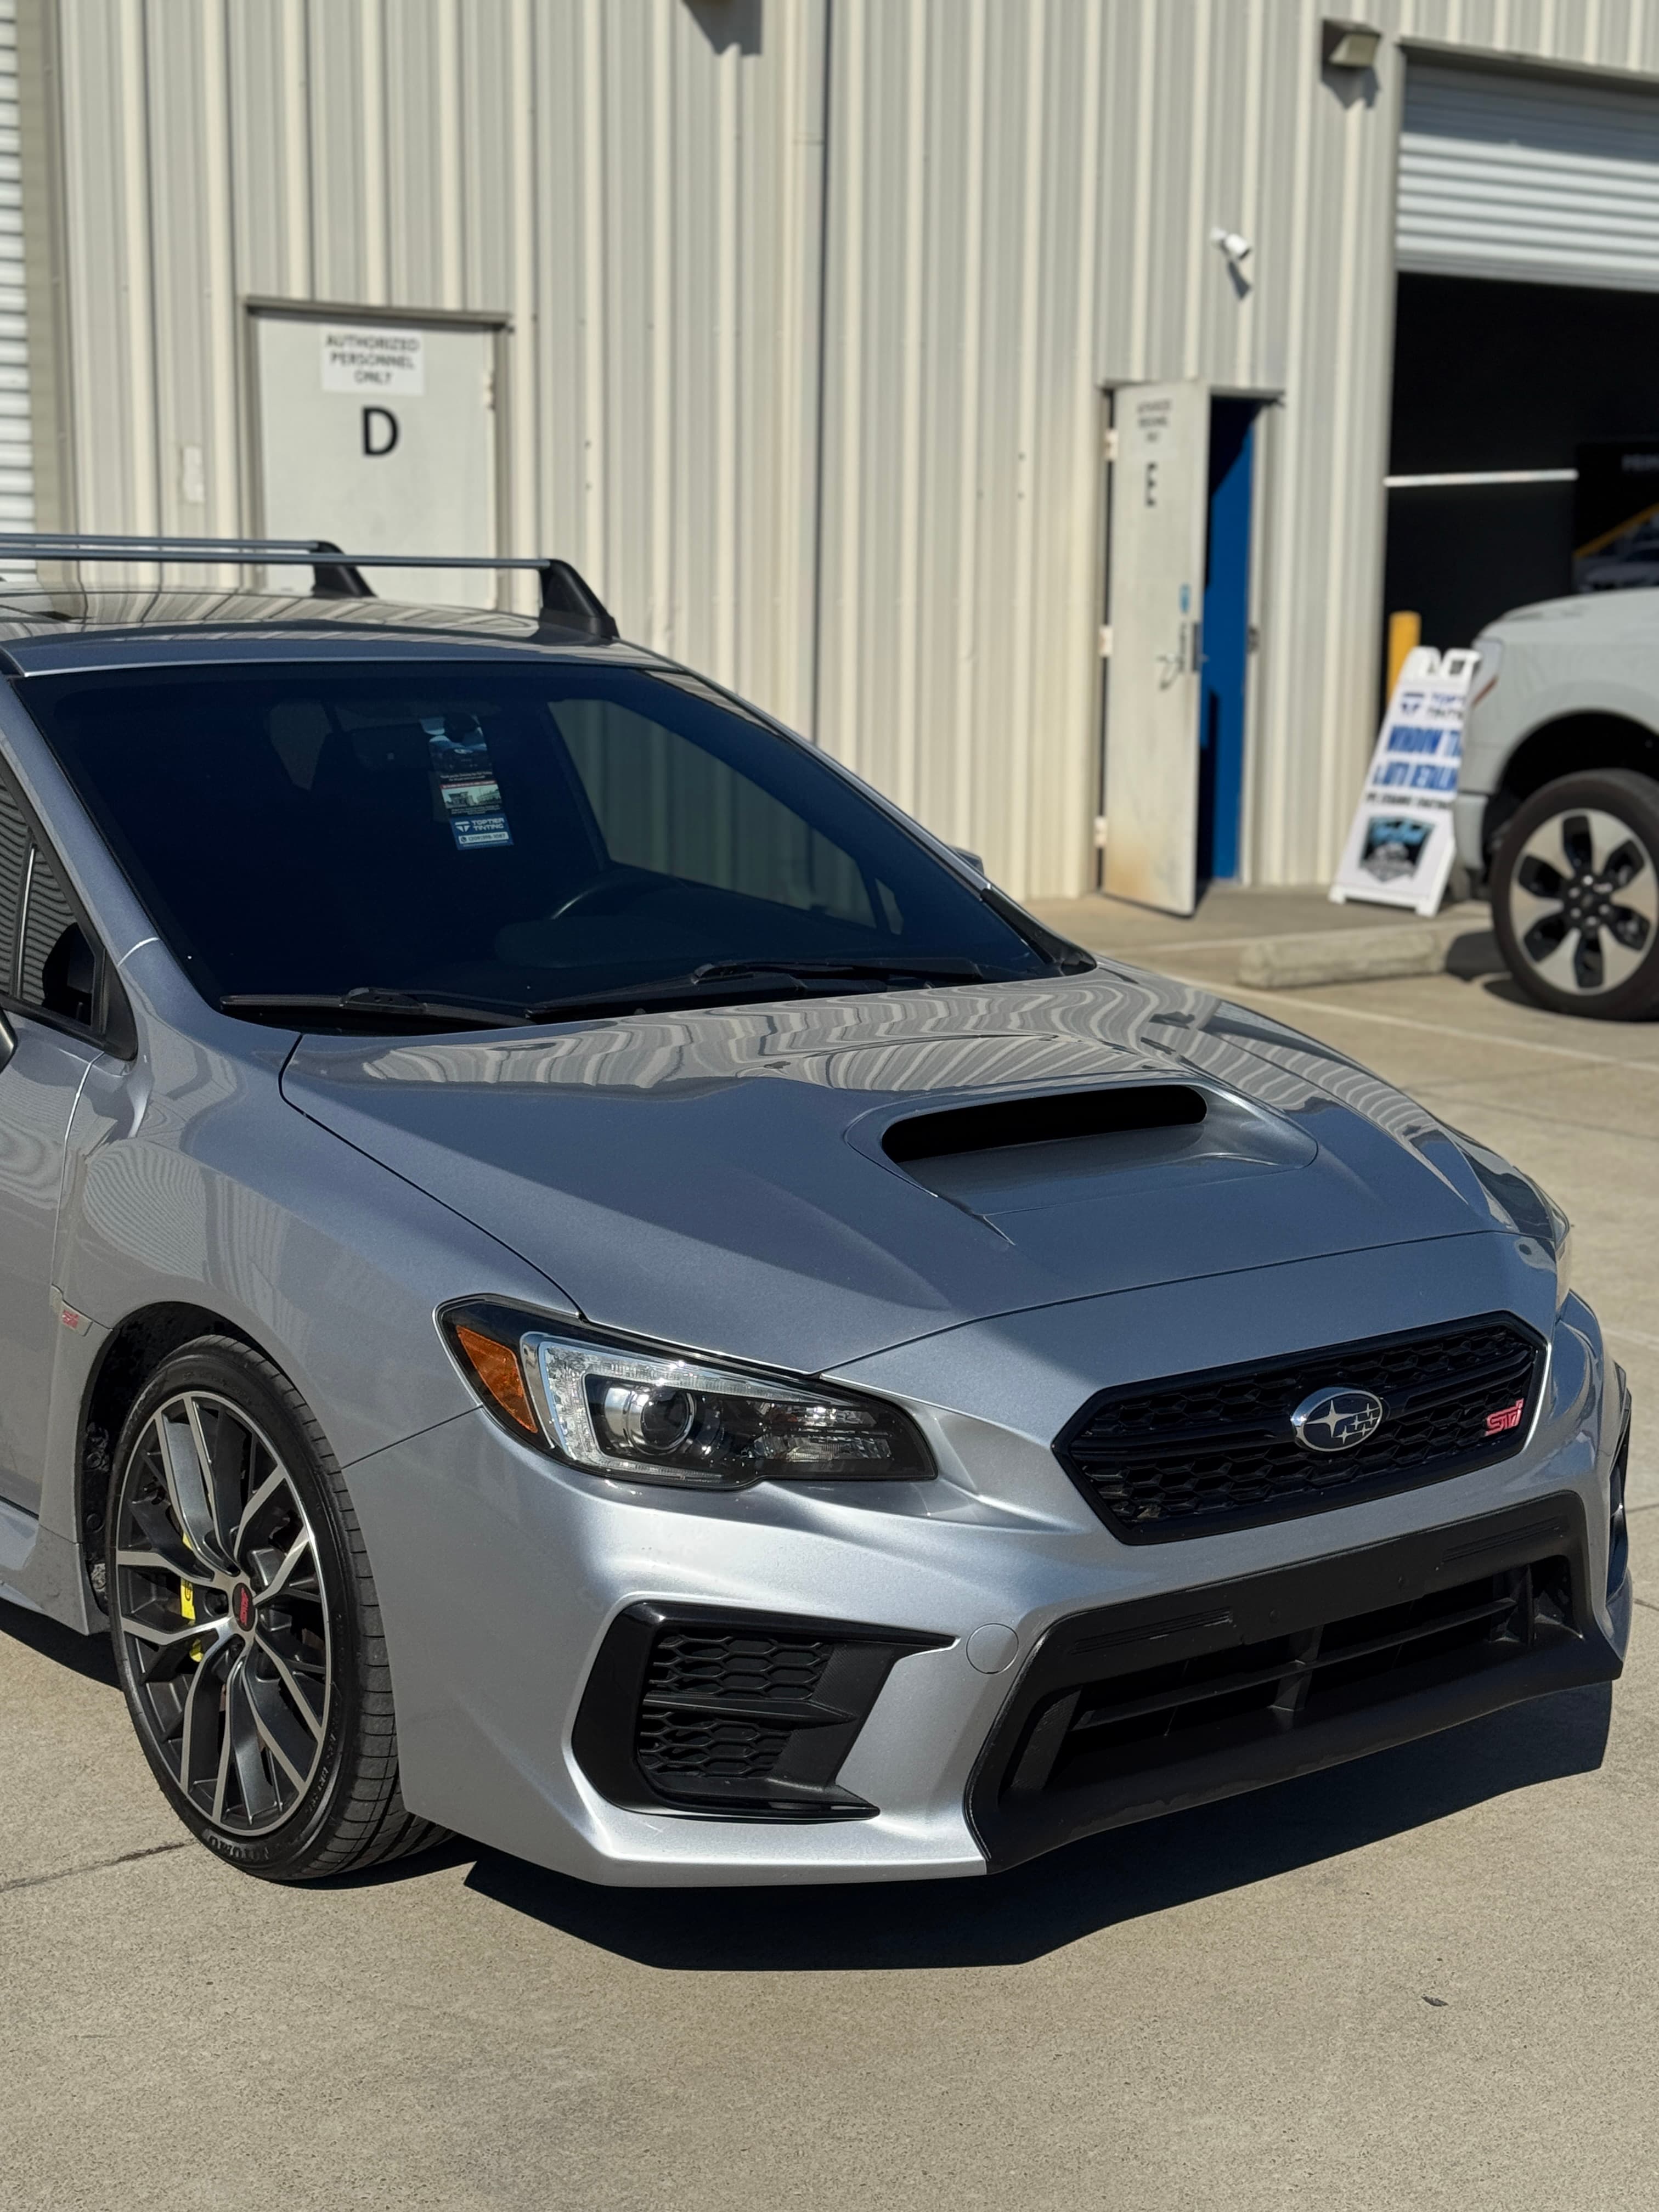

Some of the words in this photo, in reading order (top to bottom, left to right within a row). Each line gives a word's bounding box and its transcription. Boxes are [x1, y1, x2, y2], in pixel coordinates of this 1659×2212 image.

[326, 334, 420, 351] AUTHORIZED
[330, 351, 415, 370] PERSONNEL
[354, 369, 392, 386] ONLY
[362, 406, 400, 457] D
[1144, 461, 1158, 508] E
